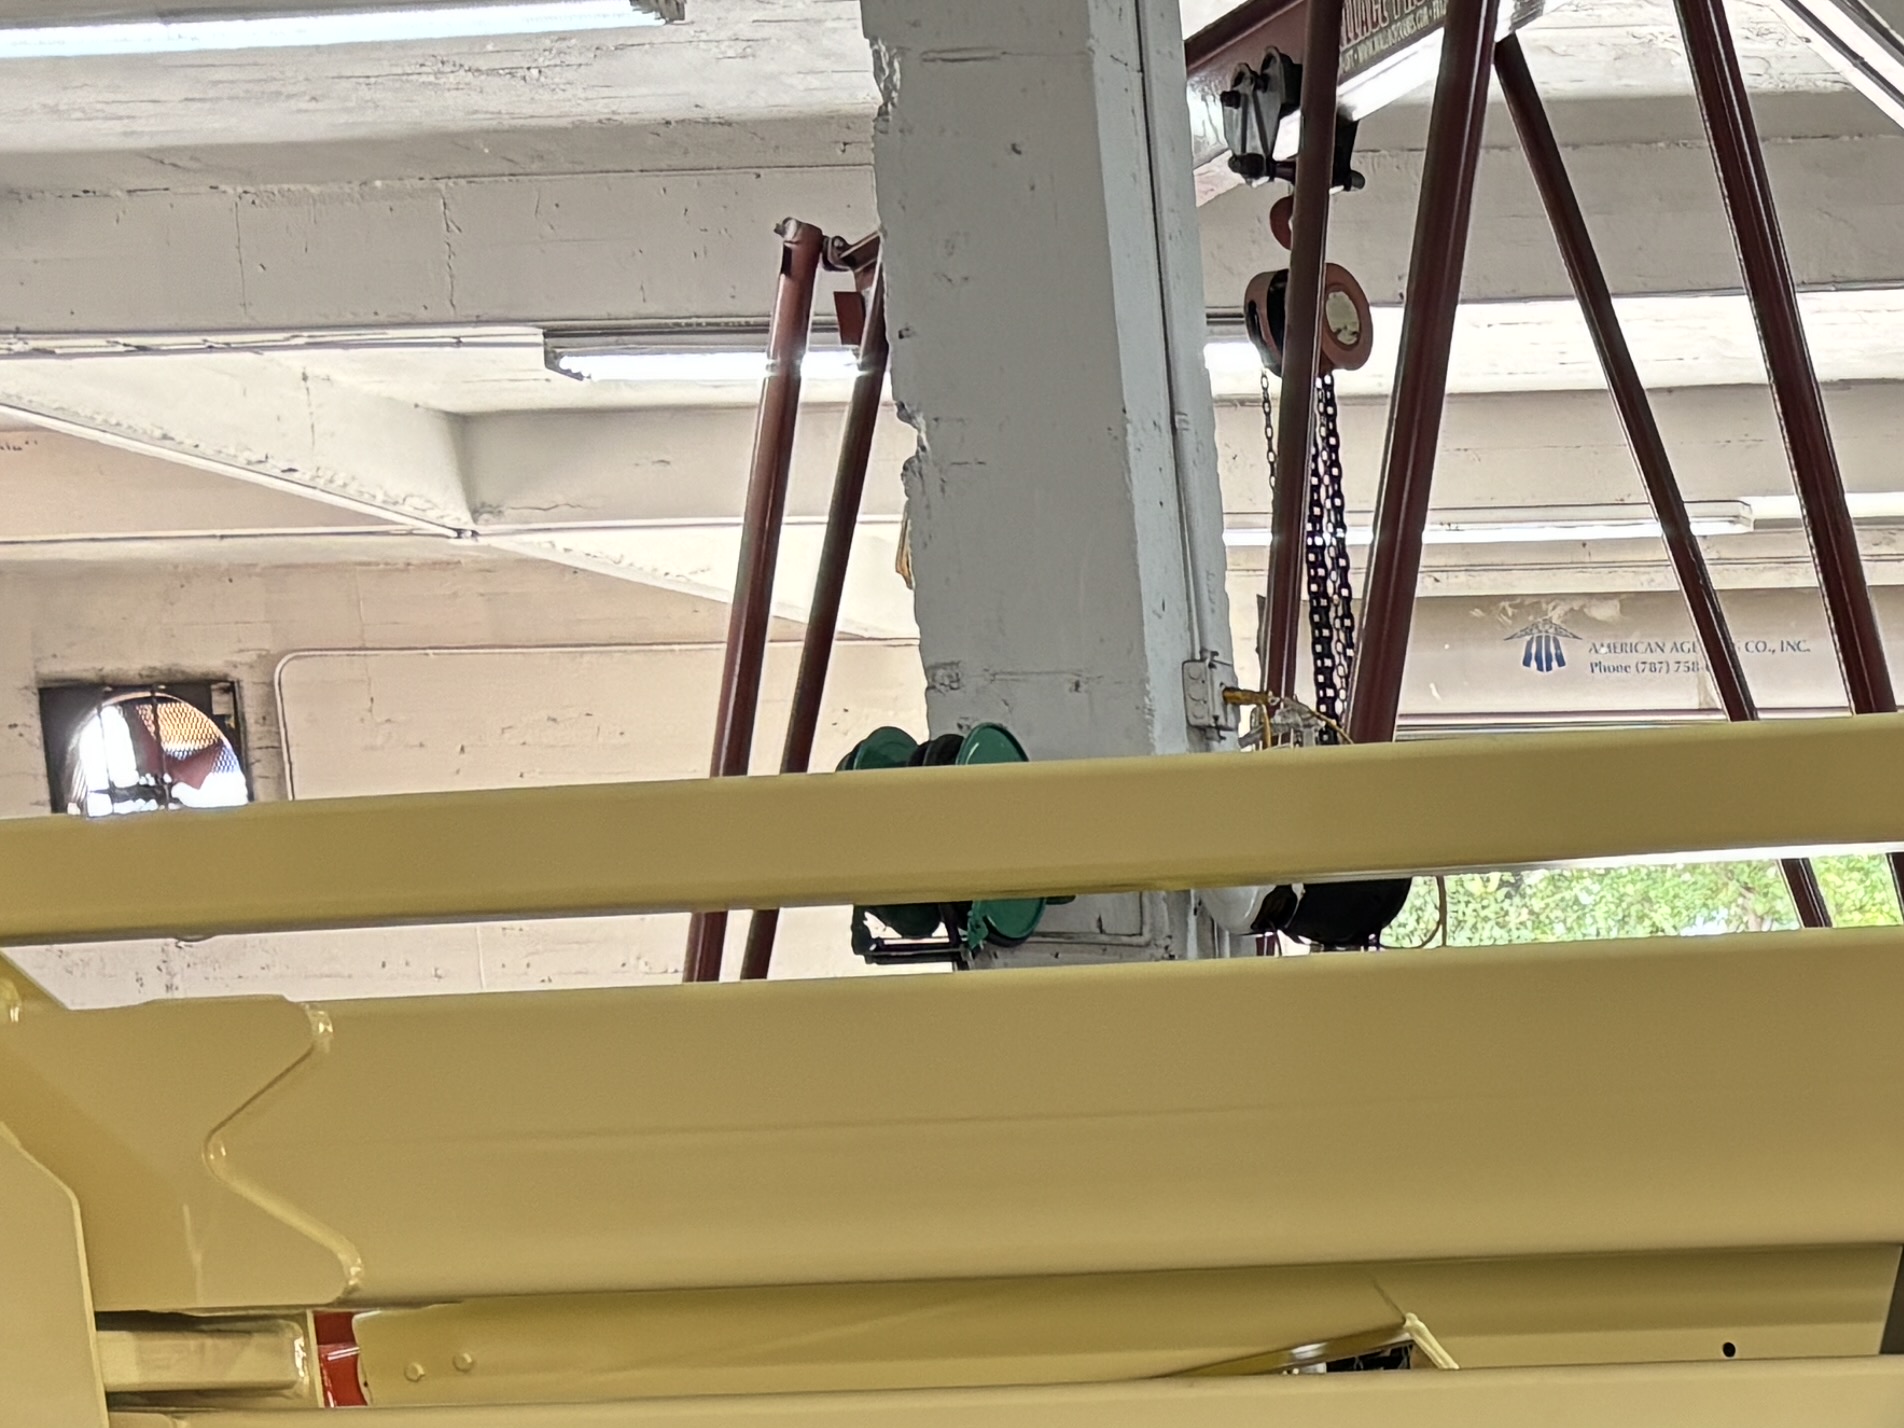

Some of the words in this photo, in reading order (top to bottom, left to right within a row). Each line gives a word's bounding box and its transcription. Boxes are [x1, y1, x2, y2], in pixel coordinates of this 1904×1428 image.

[1588, 640, 1665, 654] AMERICAN
[1745, 640, 1776, 655] CO.,
[1780, 640, 1811, 653] INC.
[1590, 661, 1631, 674] Phone
[1635, 660, 1670, 674] (787)
